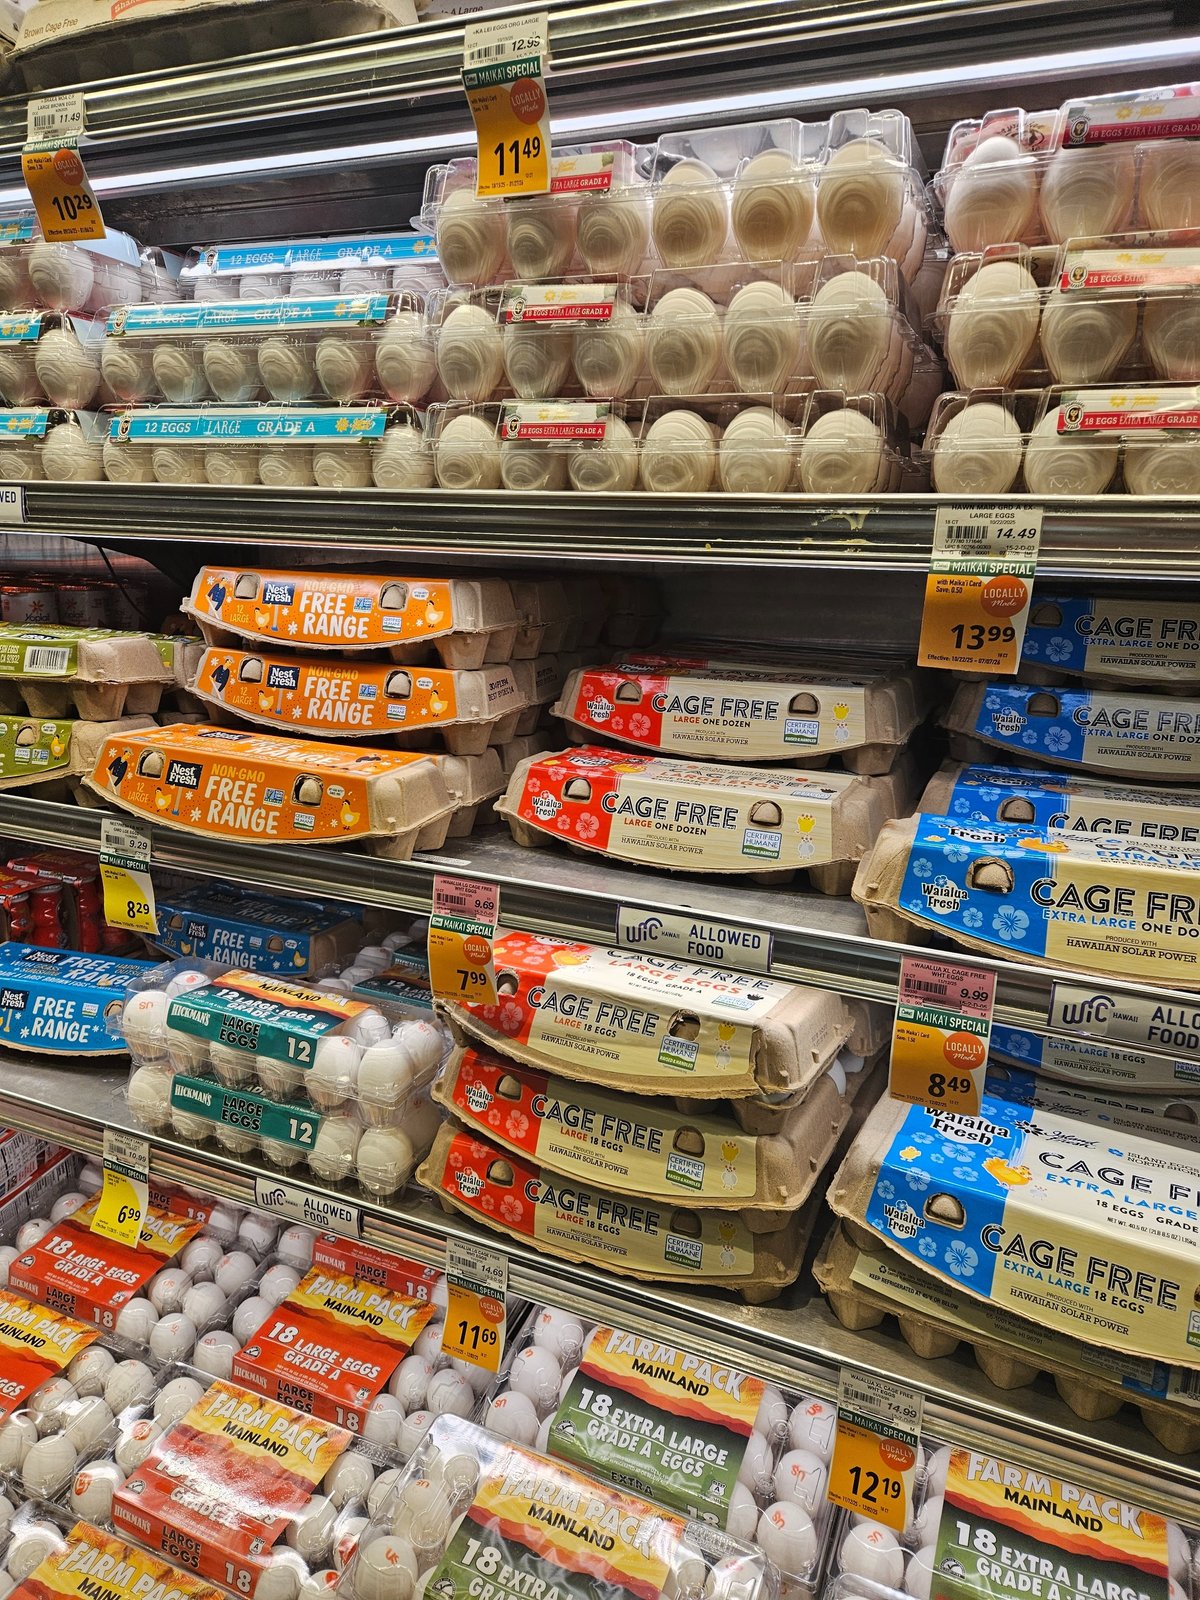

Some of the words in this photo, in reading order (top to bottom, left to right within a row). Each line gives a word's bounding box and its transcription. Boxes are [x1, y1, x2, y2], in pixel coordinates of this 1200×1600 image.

[23, 26, 44, 39] Brown
[45, 22, 62, 34] Cage
[63, 17, 78, 28] Free
[493, 23, 508, 32] EGGS
[522, 18, 539, 27] LARGE
[507, 61, 539, 78] SPECIAL
[512, 89, 540, 105] LOCALLY
[59, 112, 81, 123] 11.49
[55, 158, 79, 170] LOCALLY
[230, 253, 243, 264] 12
[245, 252, 274, 265] EGGS
[338, 245, 377, 258] GRADE
[381, 245, 392, 255] A
[145, 422, 157, 433] 12
[161, 421, 191, 433] EGGS
[206, 420, 240, 434] LARGE
[257, 420, 300, 432] GRADE
[303, 421, 315, 432] A
[544, 425, 558, 434] EXTRA
[1119, 415, 1141, 425] EXTRA
[1142, 414, 1165, 424] LARGE
[1167, 414, 1197, 423] GRADE
[996, 528, 1036, 538] 14.49
[989, 563, 1032, 574] SPECIAL
[299, 591, 347, 615] FREE
[984, 588, 1025, 598] LOCALLY
[303, 613, 369, 639] RANGE
[651, 692, 714, 717] CAGE
[720, 696, 779, 721] FREE
[170, 772, 197, 786] Fresh
[172, 763, 195, 776] Nest
[128, 791, 150, 803] LARGE
[204, 775, 257, 805] FREE
[207, 801, 280, 835] RANGE
[601, 792, 667, 821] CAGE
[674, 802, 739, 830] FREE
[623, 817, 652, 828] LARGE
[654, 821, 673, 831] ONE
[675, 824, 707, 836] DOZEN
[745, 830, 781, 842] CERTIFIED
[129, 840, 147, 850] 9.29
[744, 836, 779, 849] HUMANE
[127, 861, 147, 871] SPECIAL
[475, 900, 494, 910] 9.69
[928, 896, 959, 910] Fresh
[1030, 878, 1136, 917] CAGE
[467, 926, 492, 936] SPECIAL
[1043, 909, 1085, 923] EXTRA
[1092, 915, 1136, 930] LARGE
[1142, 922, 1172, 934] ONE
[689, 924, 761, 949] ALLOWED
[1106, 935, 1139, 944] PRODUCED
[688, 943, 724, 959] FOOD
[1067, 939, 1120, 953] HAWAIIAN
[1122, 946, 1156, 958] SOLAR
[1158, 951, 1197, 963] POWER
[952, 969, 970, 978] CAGE
[1, 998, 24, 1008] Fresh
[3, 991, 23, 1000] Nest
[960, 989, 988, 1001] 9.99
[33, 996, 76, 1019] FREE
[171, 1004, 210, 1027] HICKMAN'S
[31, 1017, 91, 1043] RANGE
[222, 1014, 260, 1037] LARGE
[950, 1017, 987, 1034] SPECIAL
[219, 1029, 257, 1050] EGGS
[287, 1037, 311, 1062] 12
[946, 1042, 983, 1054] LOCALLY
[531, 1094, 596, 1133] CAGE
[601, 1115, 663, 1154] FREE
[932, 1118, 992, 1145] Fresh
[482, 1265, 503, 1277] 14.69
[980, 1224, 1077, 1278] CAGE
[1087, 1257, 1180, 1311] FREE
[305, 1276, 363, 1304] FARM
[365, 1293, 416, 1330] PACK
[323, 1298, 383, 1326] MAINLAND
[1010, 1288, 1059, 1311] HAWAIIAN
[1060, 1306, 1092, 1323] SOLAR
[1094, 1317, 1129, 1335] POWER
[268, 1322, 299, 1343] 18
[294, 1339, 340, 1364] LARGE
[343, 1358, 381, 1379] EGGS
[283, 1350, 329, 1376] GRADE
[328, 1369, 341, 1381] A
[605, 1329, 683, 1366] FARM
[686, 1353, 747, 1401] PACK
[631, 1359, 710, 1397] MAINLAND
[887, 1402, 917, 1418] 14.99
[578, 1387, 613, 1419] 18
[612, 1408, 665, 1440] EXTRA
[668, 1431, 729, 1466] LARGE
[884, 1426, 916, 1446] SPECIAL
[587, 1417, 638, 1456] GRADE
[639, 1441, 651, 1457] A
[660, 1451, 704, 1478] EGGS
[881, 1443, 913, 1458] LOCALLY
[967, 1453, 1052, 1495] FARM
[1061, 1483, 1144, 1538] PACK
[1003, 1488, 1103, 1533] MAINLAND
[162, 1526, 201, 1555] LARGE
[161, 1538, 199, 1569] EGGS
[224, 1562, 252, 1592] 18
